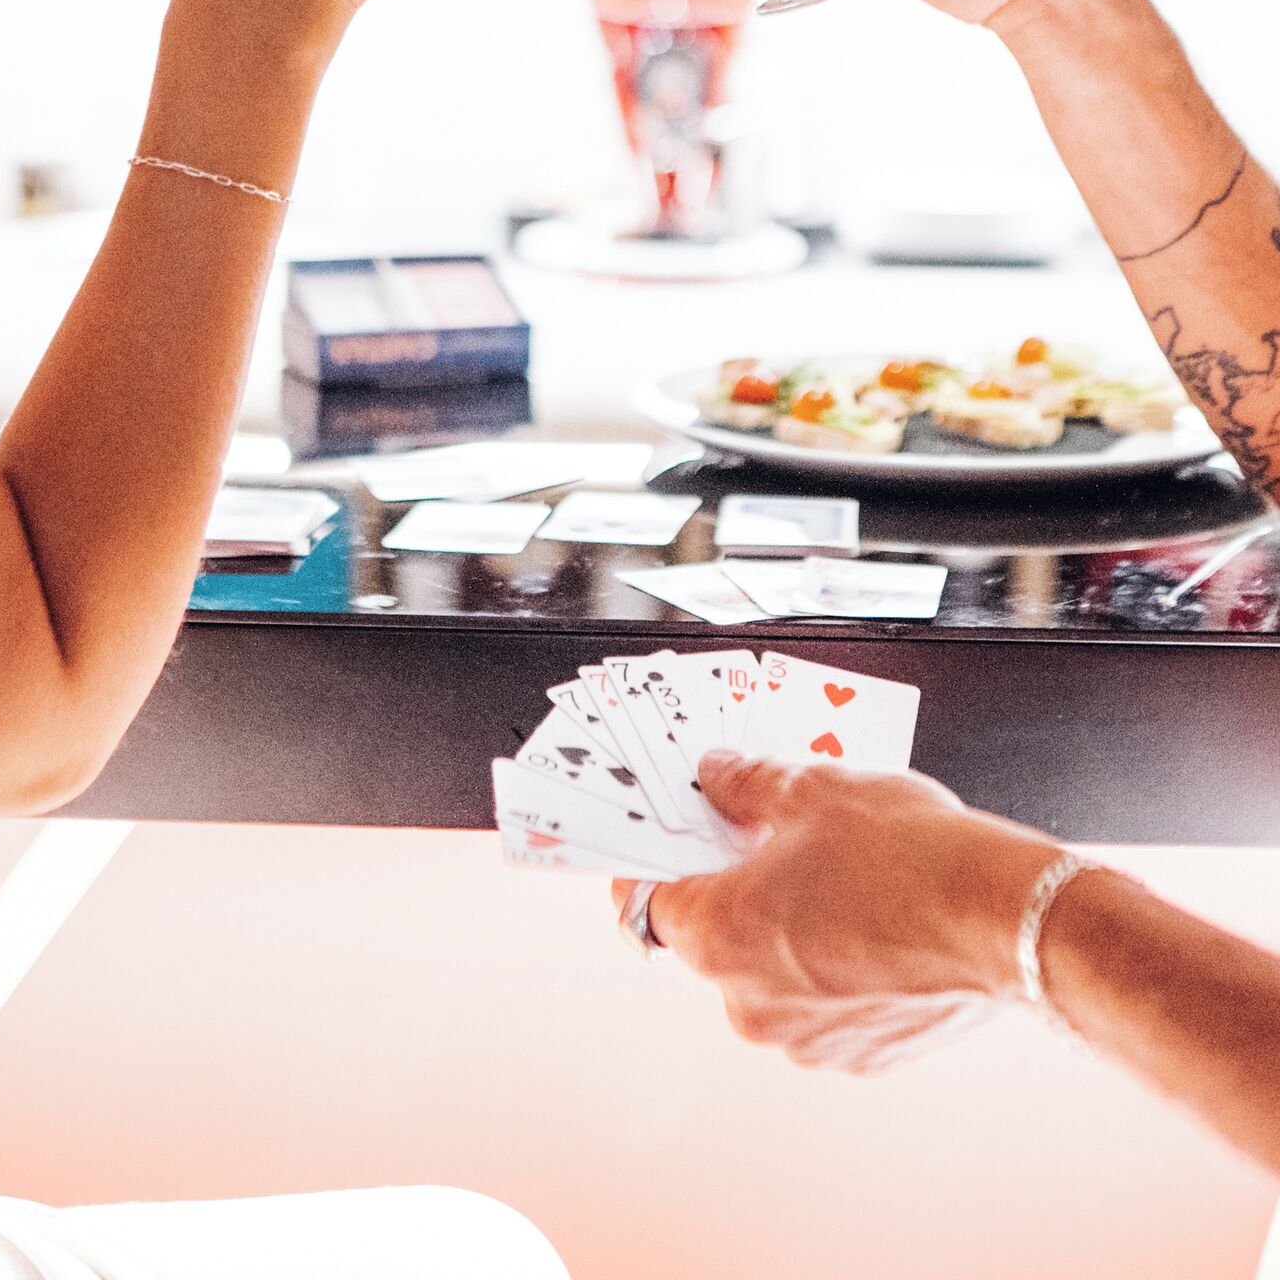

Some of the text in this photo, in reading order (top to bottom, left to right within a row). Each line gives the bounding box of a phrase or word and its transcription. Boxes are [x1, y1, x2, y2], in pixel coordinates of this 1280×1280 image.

[611, 662, 629, 682] 7
[728, 668, 747, 689] 10
[768, 659, 787, 678] 3
[589, 673, 608, 694] 7
[557, 690, 580, 711] 7
[658, 687, 681, 707] 3
